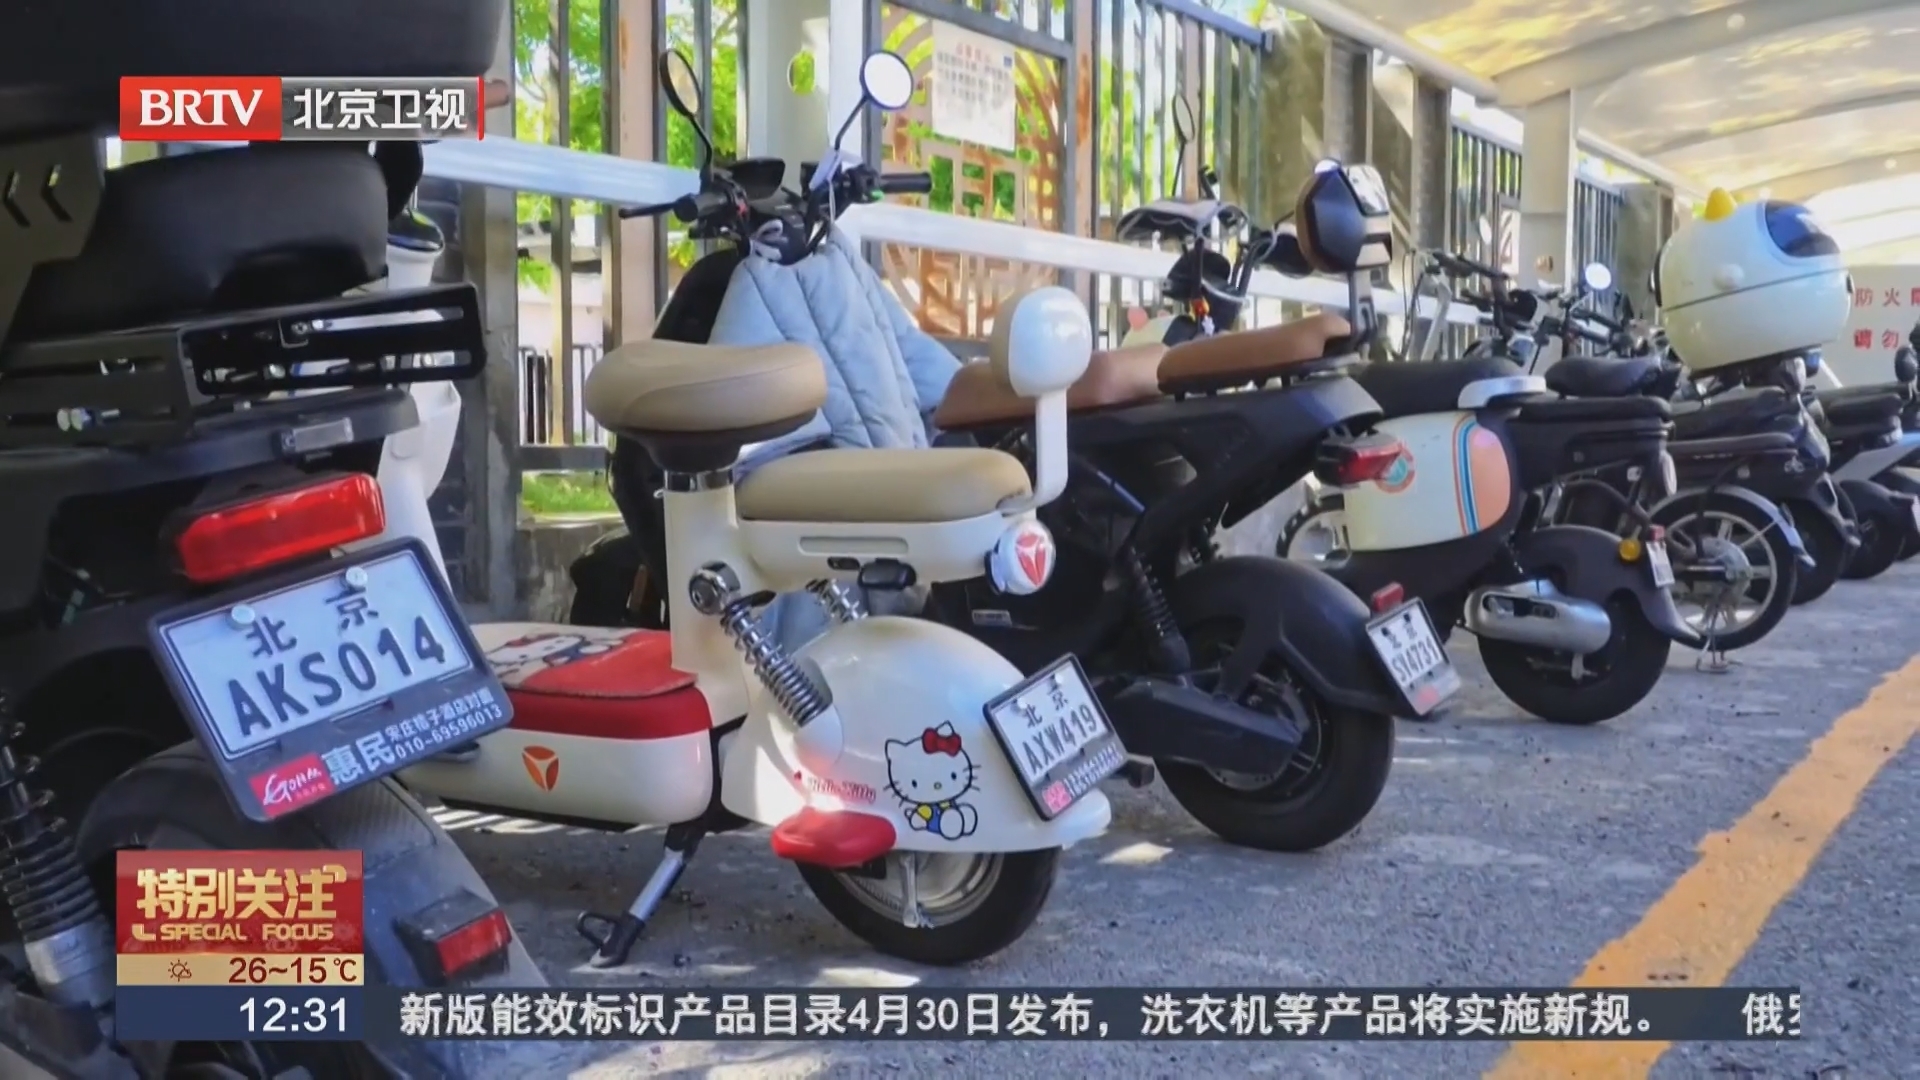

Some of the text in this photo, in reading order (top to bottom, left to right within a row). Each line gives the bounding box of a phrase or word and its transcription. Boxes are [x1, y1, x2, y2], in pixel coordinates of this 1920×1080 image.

[228, 616, 445, 737] AKS014
[321, 731, 396, 786] 惠民
[1022, 704, 1098, 775] AXW419
